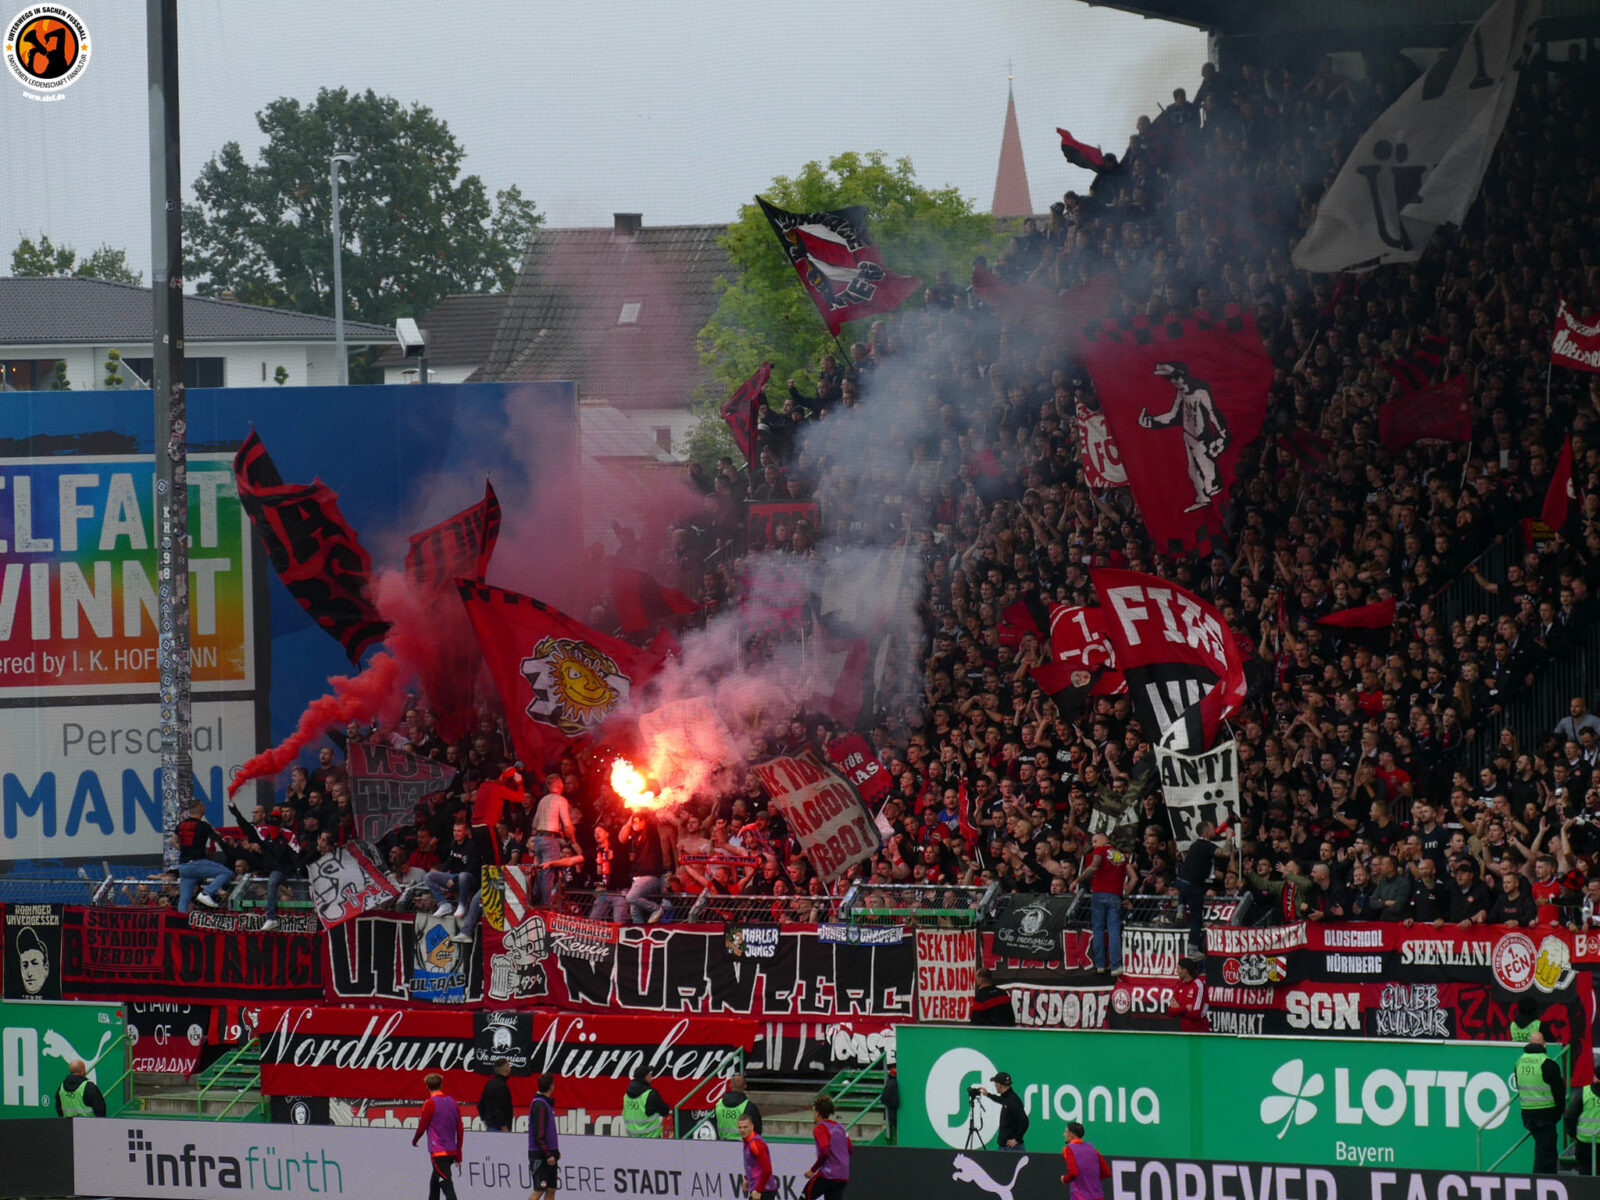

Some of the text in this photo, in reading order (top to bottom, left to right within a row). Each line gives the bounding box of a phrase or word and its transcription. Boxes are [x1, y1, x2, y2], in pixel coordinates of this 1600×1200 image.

[43, 655, 66, 677] by
[90, 650, 108, 671] K.
[62, 717, 223, 757] Persoal
[1161, 749, 1233, 787] ANTI
[6, 914, 60, 926] UNVERGESSEN
[87, 911, 159, 930] SEKTION
[550, 917, 612, 940] DURCHHALTEN
[87, 931, 159, 948] STADION
[550, 931, 610, 958] Kevin
[917, 932, 975, 962] SEKTION
[1206, 922, 1307, 953] DIE BESESSENEN
[1324, 930, 1383, 947] OLDSCHOOL
[90, 948, 156, 966] VERBOT
[745, 945, 776, 958] JUNGS
[1326, 953, 1382, 973] NÜRNBERG
[919, 965, 975, 991] STADION
[1504, 954, 1530, 979] FCN
[410, 973, 467, 993] ULTRAS
[520, 973, 543, 990] 1994
[1380, 982, 1441, 1011] GLUBB
[486, 1011, 519, 1026] Mausi
[1286, 990, 1360, 1030] SGN
[154, 1024, 173, 1047] OF
[260, 1007, 475, 1073] Nordkurve
[531, 1018, 742, 1103] Nürnberg
[1521, 1065, 1536, 1076] 191
[626, 1101, 640, 1111] 190
[1335, 1068, 1510, 1130] LOTTO
[721, 1109, 737, 1119] 188
[1336, 1141, 1395, 1167] Bayern
[469, 1156, 510, 1188] FÜR
[518, 1162, 606, 1193] USERE
[614, 1167, 683, 1197] STADT
[691, 1172, 722, 1199] AM
